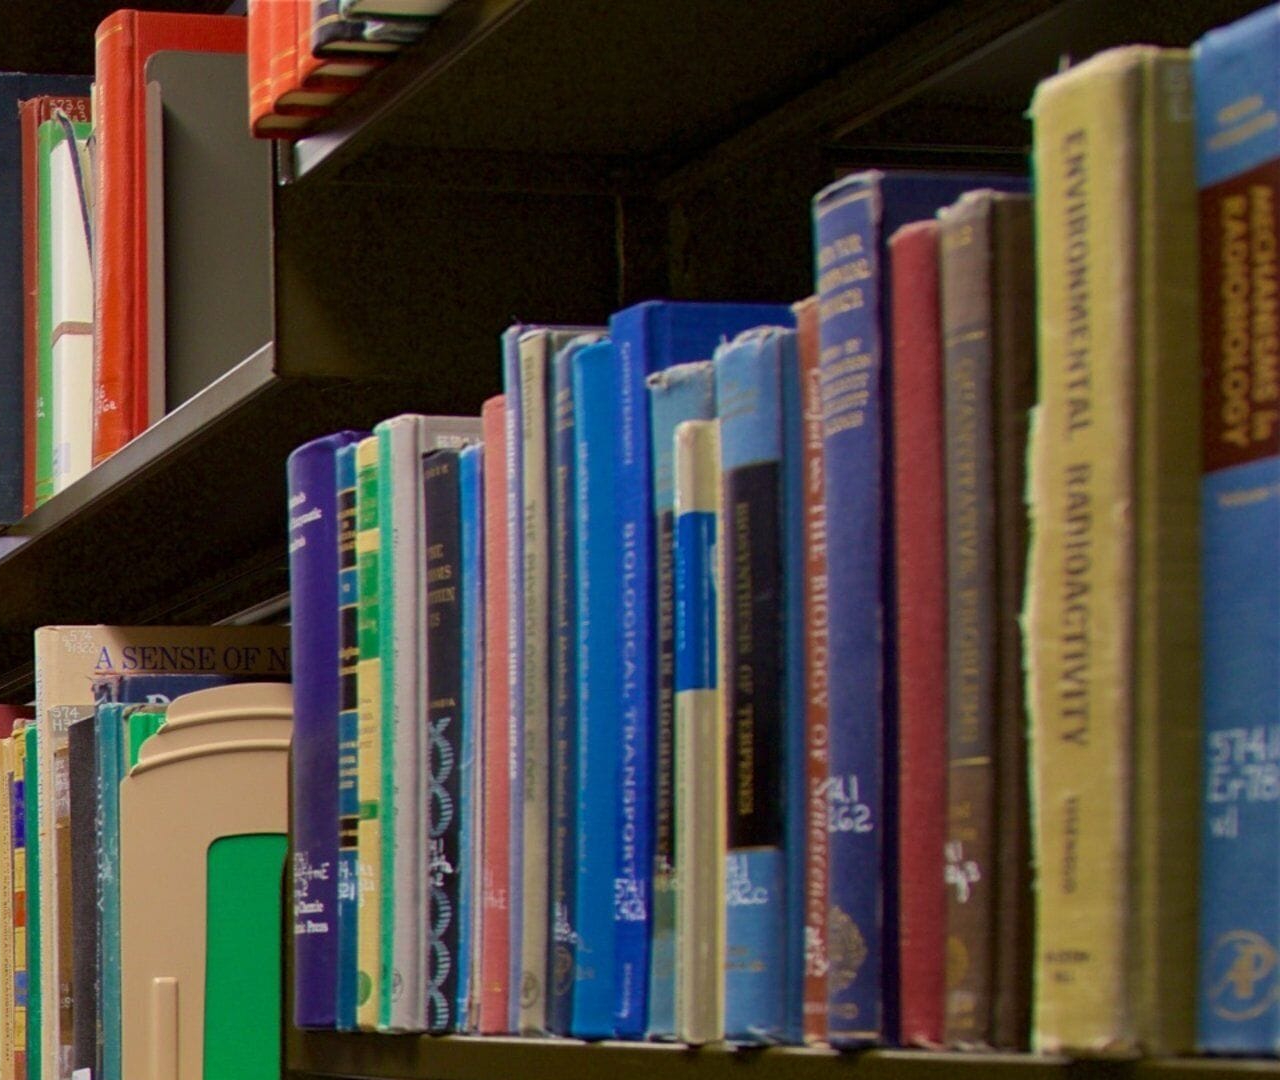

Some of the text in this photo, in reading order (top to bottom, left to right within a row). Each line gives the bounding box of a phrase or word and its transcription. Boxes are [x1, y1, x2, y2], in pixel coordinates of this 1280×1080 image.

[1058, 128, 1092, 748] ENVIRONMENTAL RADIOACTIVITY
[810, 502, 828, 562] THE
[95, 646, 288, 671] A SENSE OF N
[810, 573, 829, 710] BIOLOGY
[52, 707, 80, 719] 574
[623, 521, 636, 880] BIOLOGICAL TRANSPORT
[810, 723, 829, 761] OF
